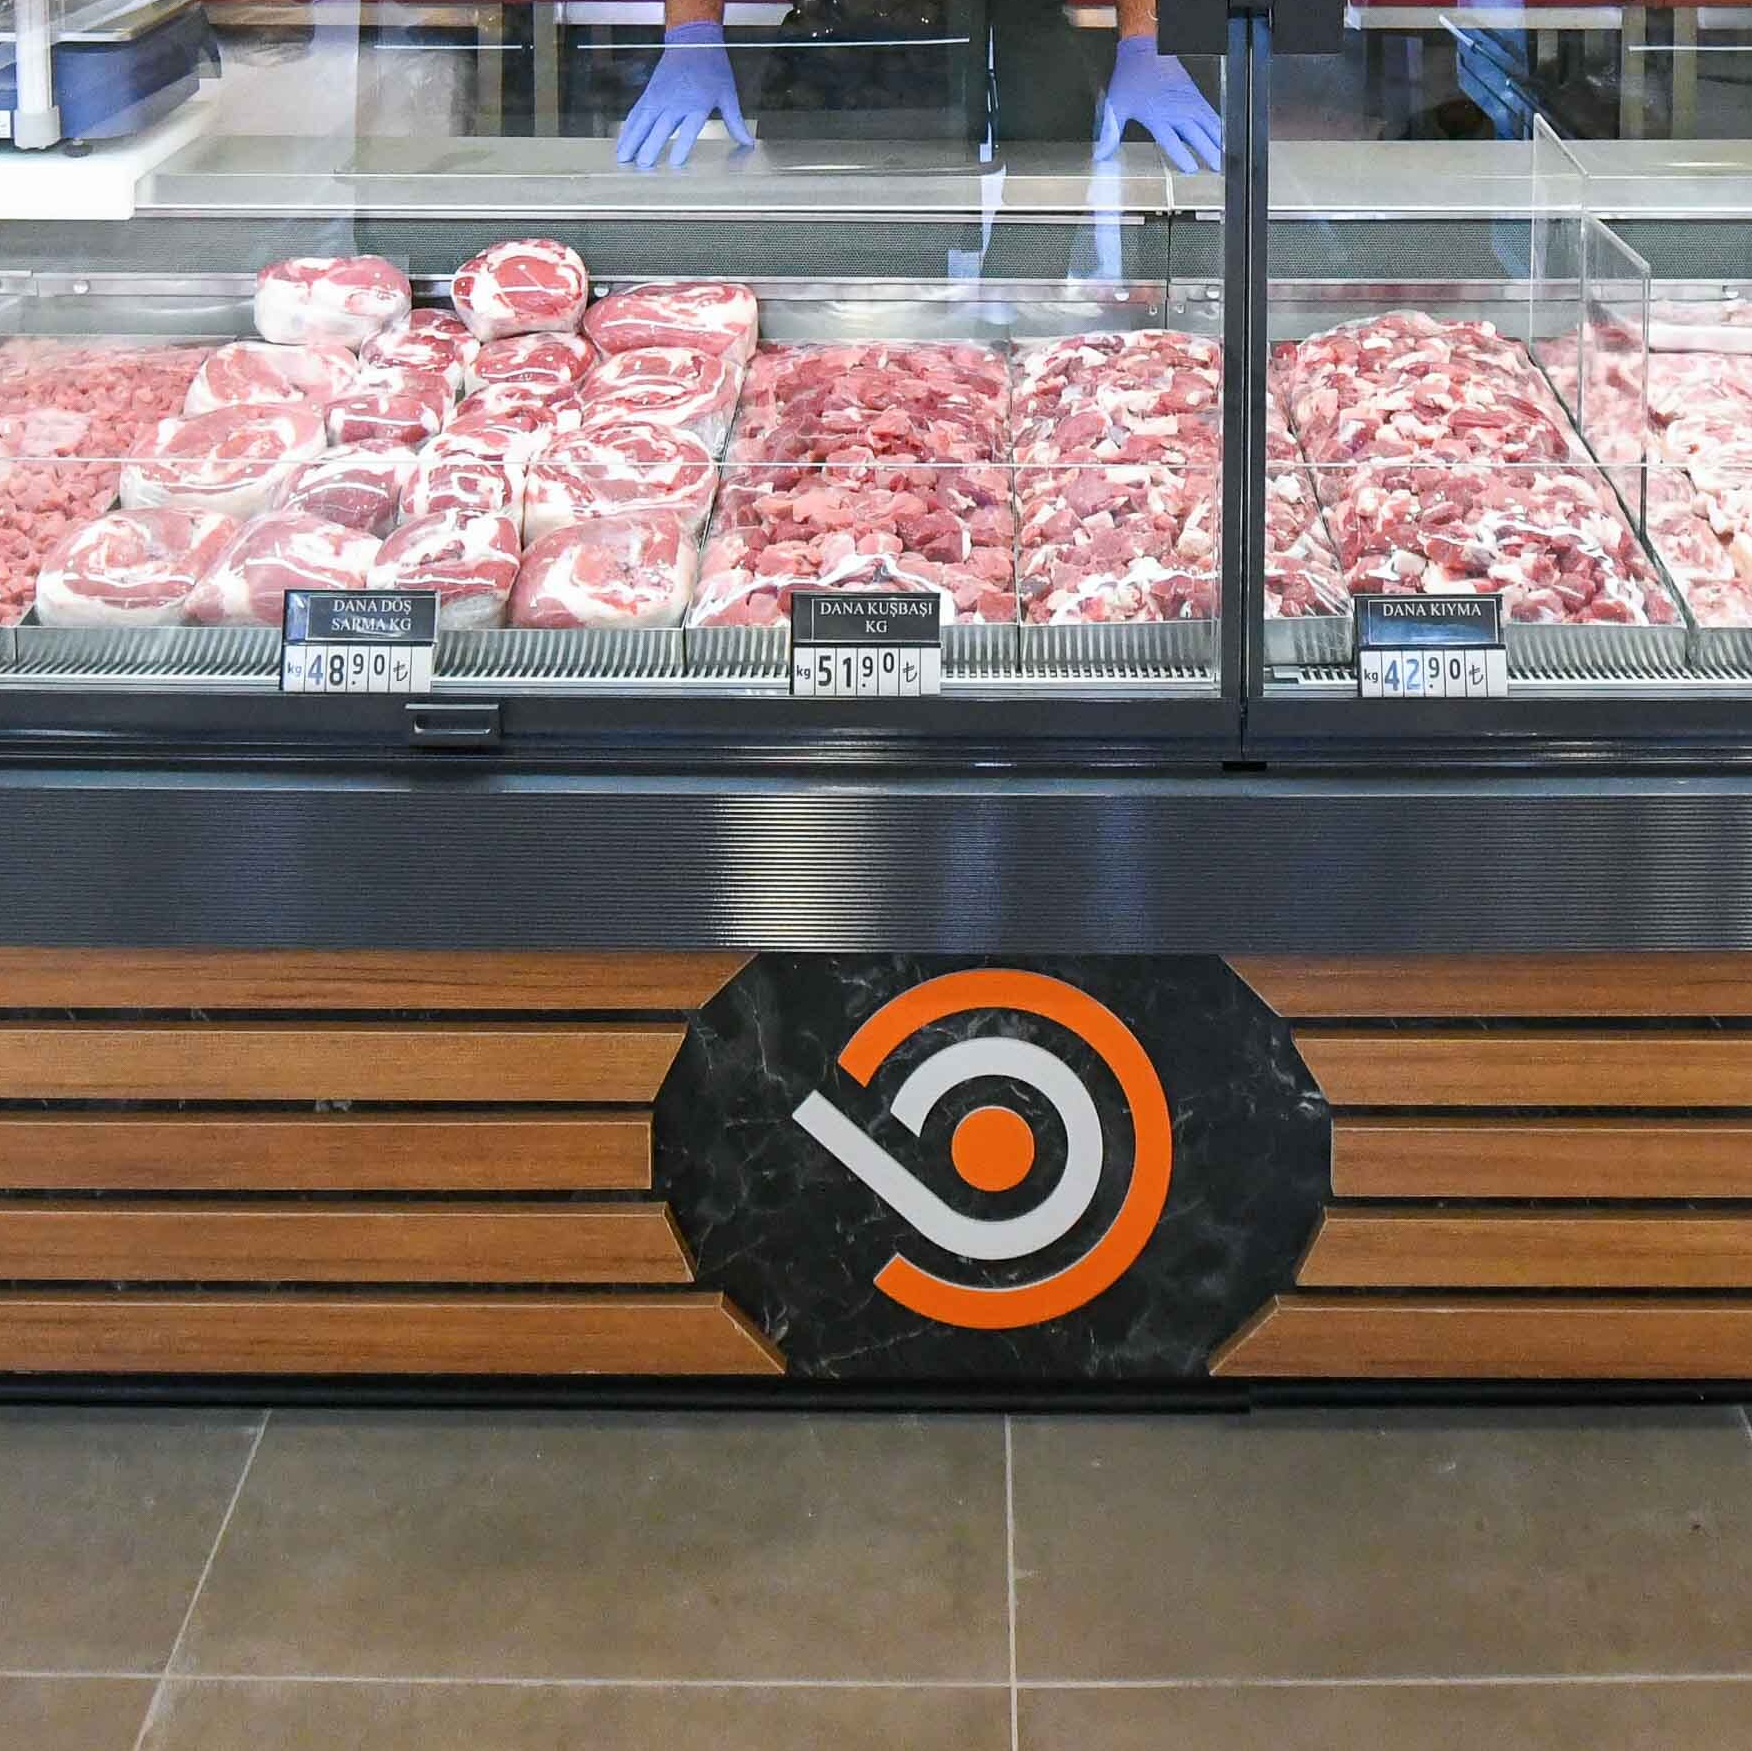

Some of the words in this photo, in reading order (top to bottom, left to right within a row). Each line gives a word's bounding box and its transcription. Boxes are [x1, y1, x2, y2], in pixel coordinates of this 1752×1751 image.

[333, 599, 378, 613] DANA
[820, 602, 865, 616] DANA
[867, 602, 933, 618] KUŞBAŞI
[1382, 603, 1427, 617] DANA
[1430, 603, 1482, 617] KIYMA
[331, 617, 386, 632] SARMA
[389, 617, 412, 632] KG
[865, 620, 889, 634] KG
[307, 653, 386, 686] 48.90
[796, 665, 811, 680] kg
[817, 652, 895, 688] 51.90
[1364, 668, 1379, 683] kg
[1384, 657, 1462, 691] 42.90
